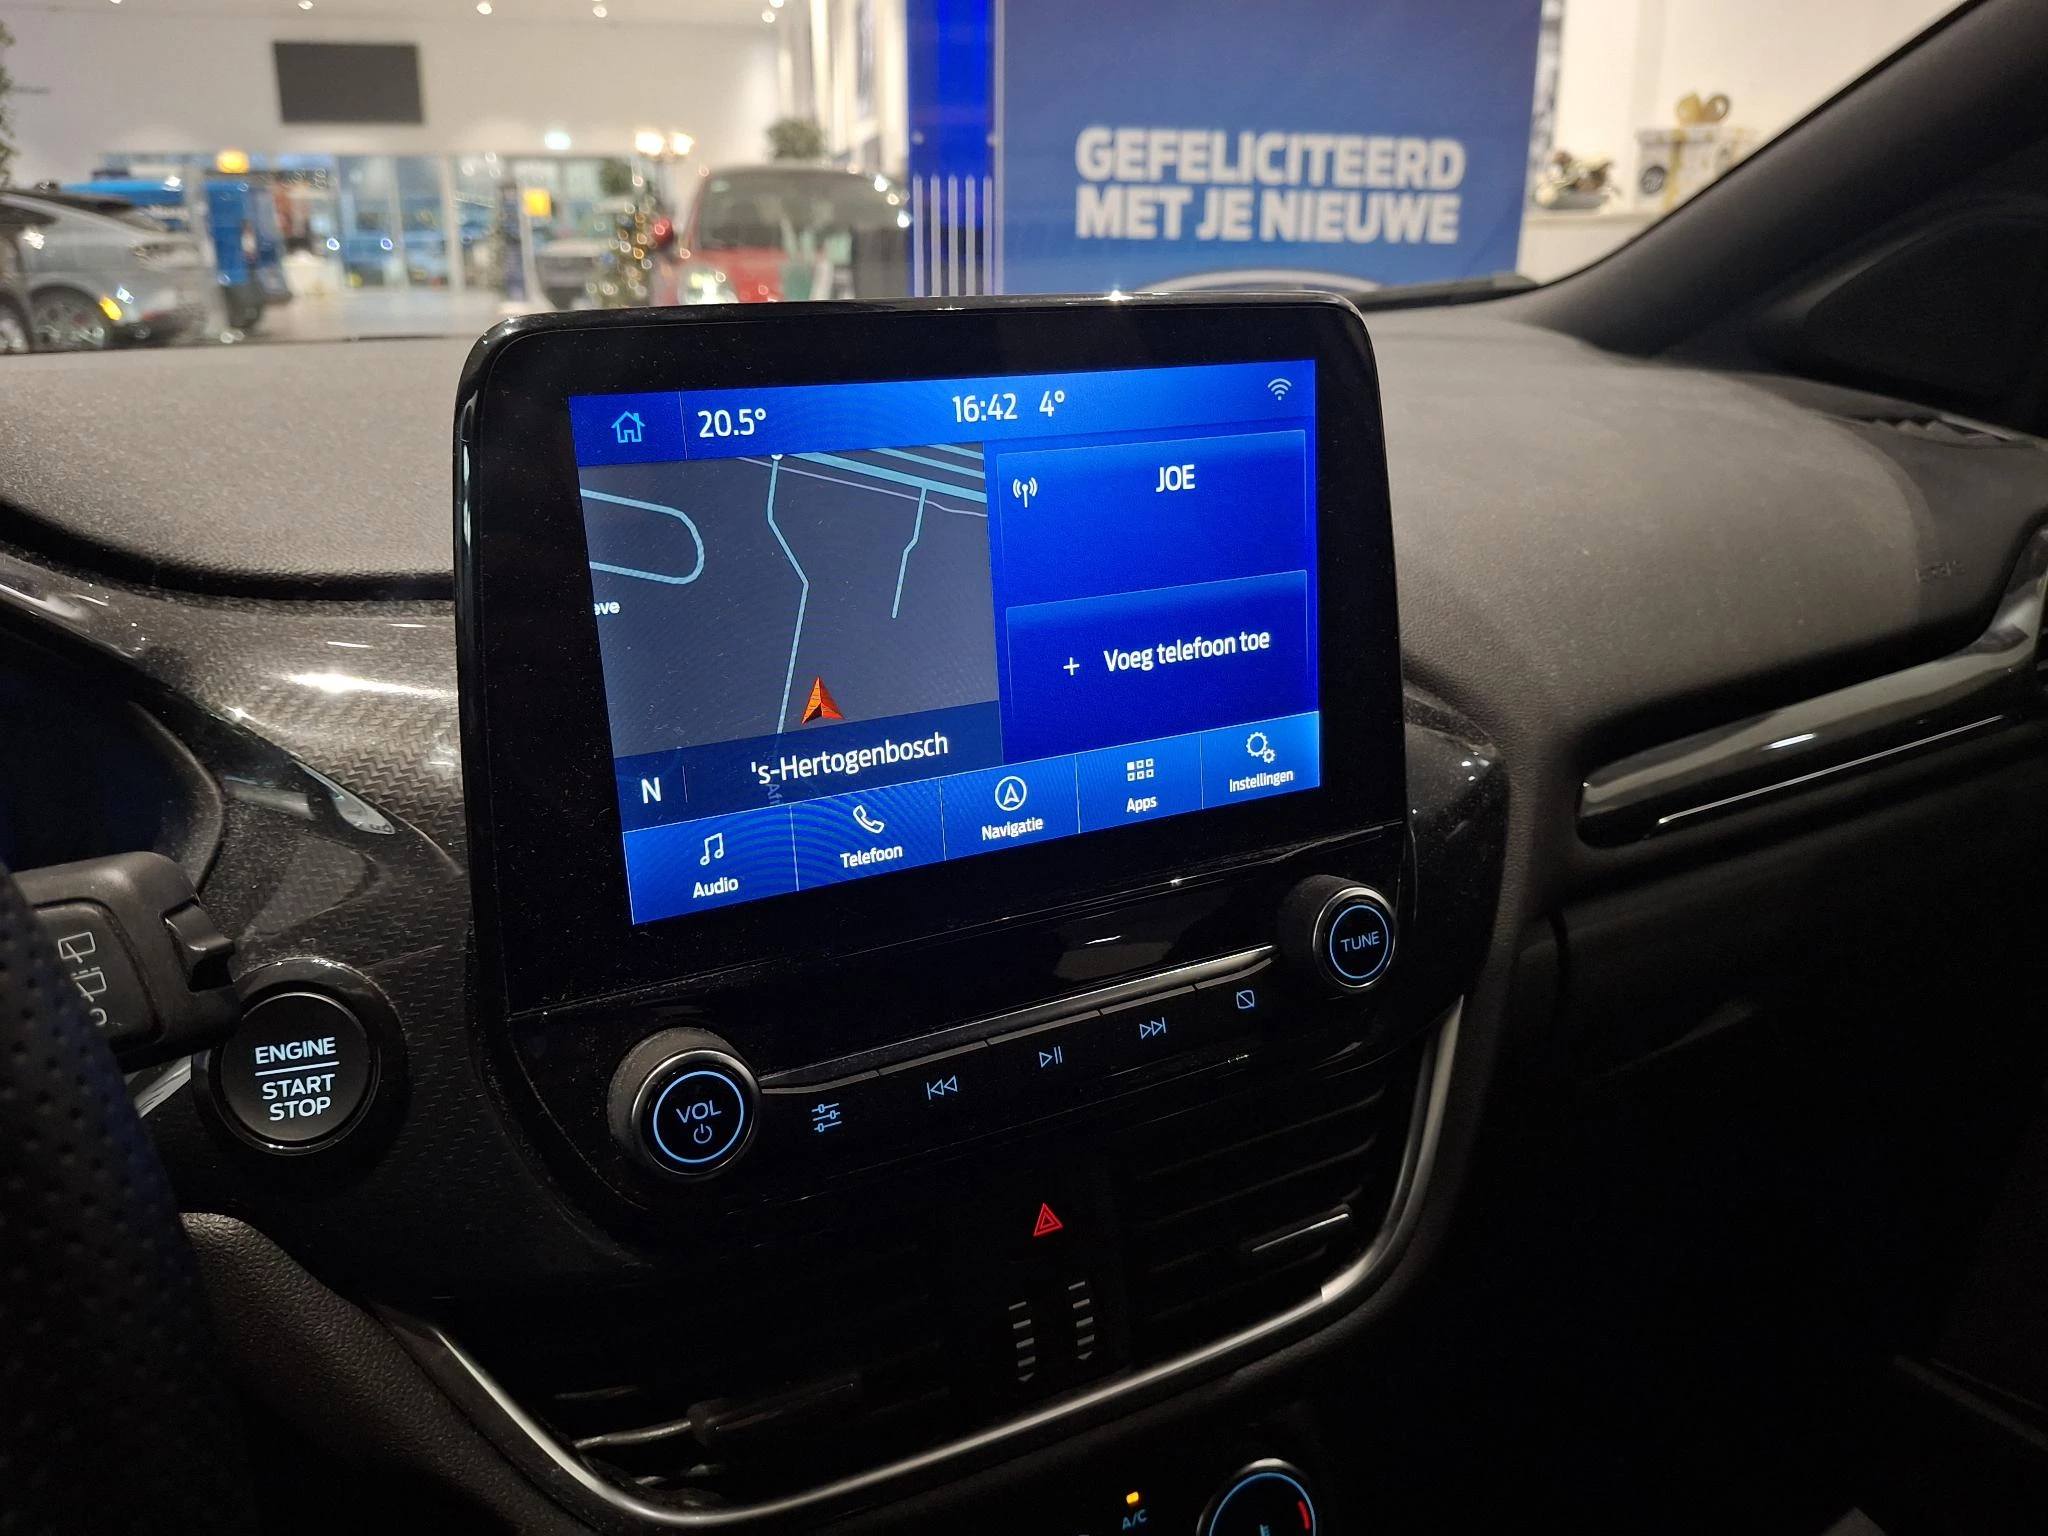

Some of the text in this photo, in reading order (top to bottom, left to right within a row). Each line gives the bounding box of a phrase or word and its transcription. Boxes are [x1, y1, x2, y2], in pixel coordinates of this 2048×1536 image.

[1075, 126, 1467, 191] GEFELICITEERD
[1075, 185, 1461, 244] MET JE NIEUWE
[952, 392, 1018, 423] 16:42
[1038, 389, 1066, 417] 4°
[697, 407, 767, 438] 20.5°
[1154, 463, 1197, 494] JOE
[1103, 631, 1271, 673] Voeg telefoon toe
[750, 732, 949, 785] 's-Hertogenbosch
[641, 776, 662, 804] N
[1229, 767, 1294, 793] Instellingen
[1126, 796, 1158, 815] Apps
[981, 816, 1044, 842] Navigatie
[839, 844, 903, 869] Telefoon
[692, 876, 740, 899] Audio
[1340, 930, 1380, 953] TUNE
[255, 1037, 336, 1065] ENGINE
[261, 1073, 336, 1100] START
[268, 1096, 331, 1121] STOP
[675, 1099, 722, 1124] VOL
[1122, 1508, 1148, 1531] A/C
